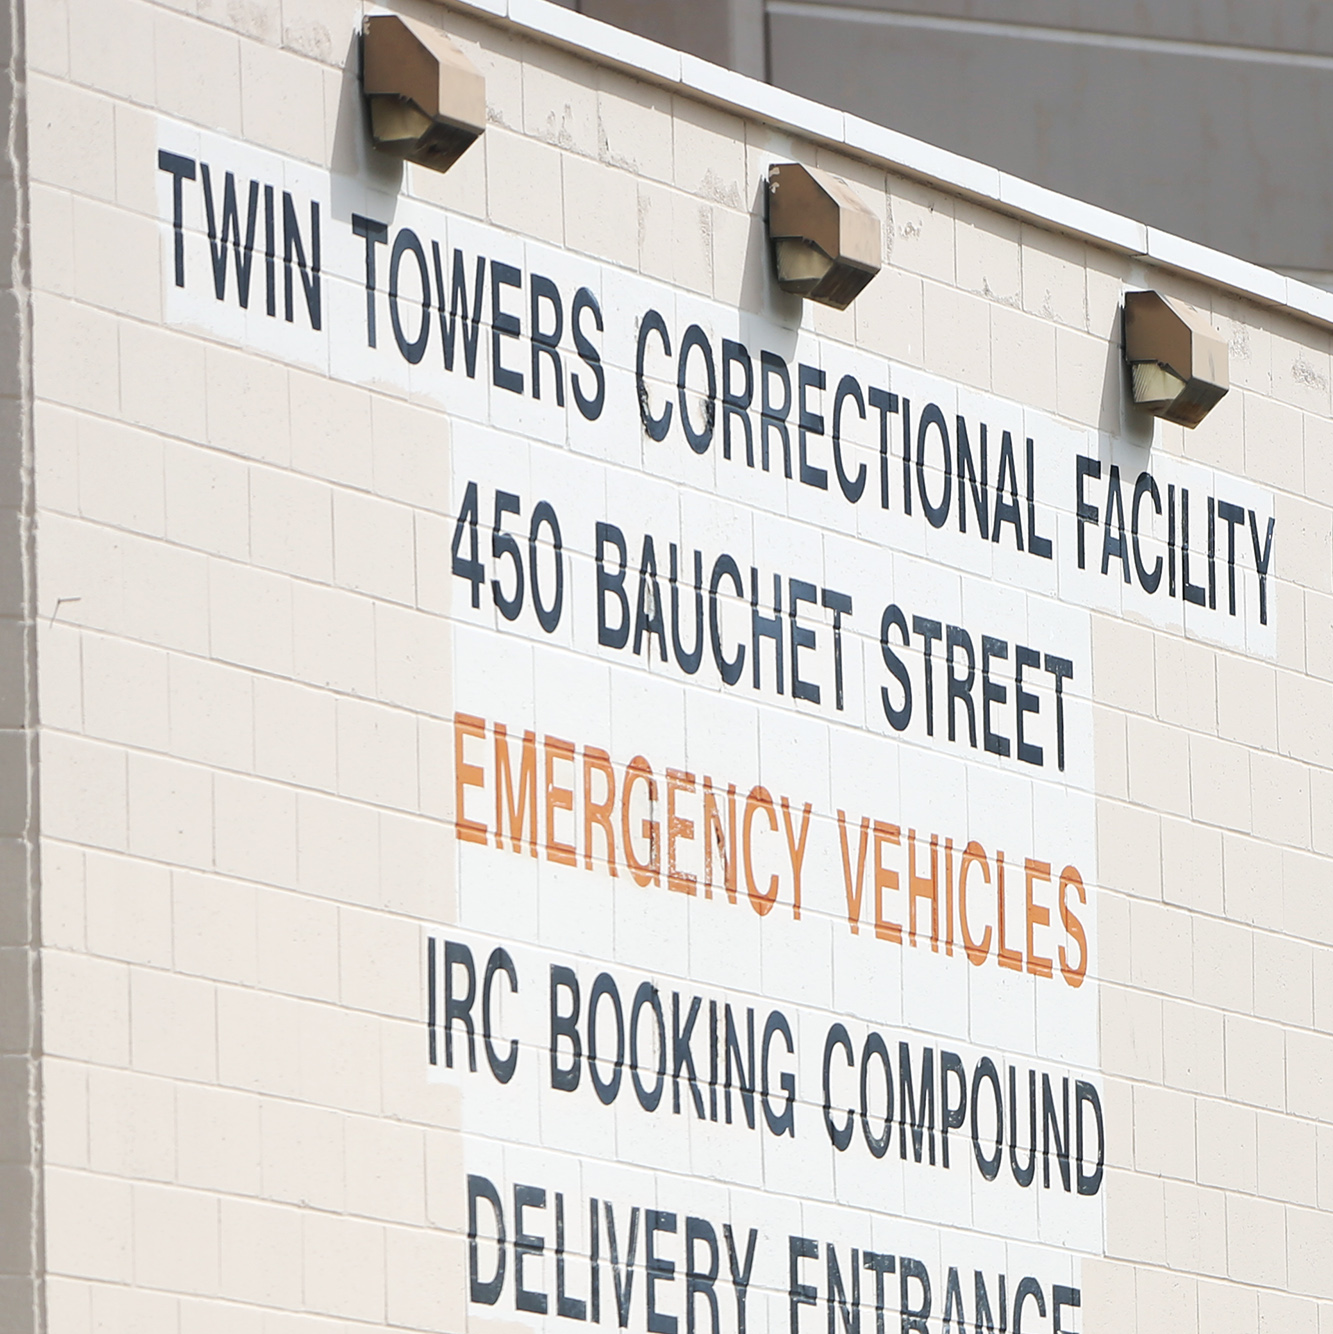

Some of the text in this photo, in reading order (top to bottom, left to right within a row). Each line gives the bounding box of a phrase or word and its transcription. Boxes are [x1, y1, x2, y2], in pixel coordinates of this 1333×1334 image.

[159, 150, 1275, 625] TWIN TOWERS CORRECTIONAL FACILITY
[452, 482, 1073, 771] 450 BAUCHET STREET
[454, 713, 1087, 988] EMERGENCY VEHICLES
[428, 938, 1104, 1195] IRC BOOKING COMPOUND
